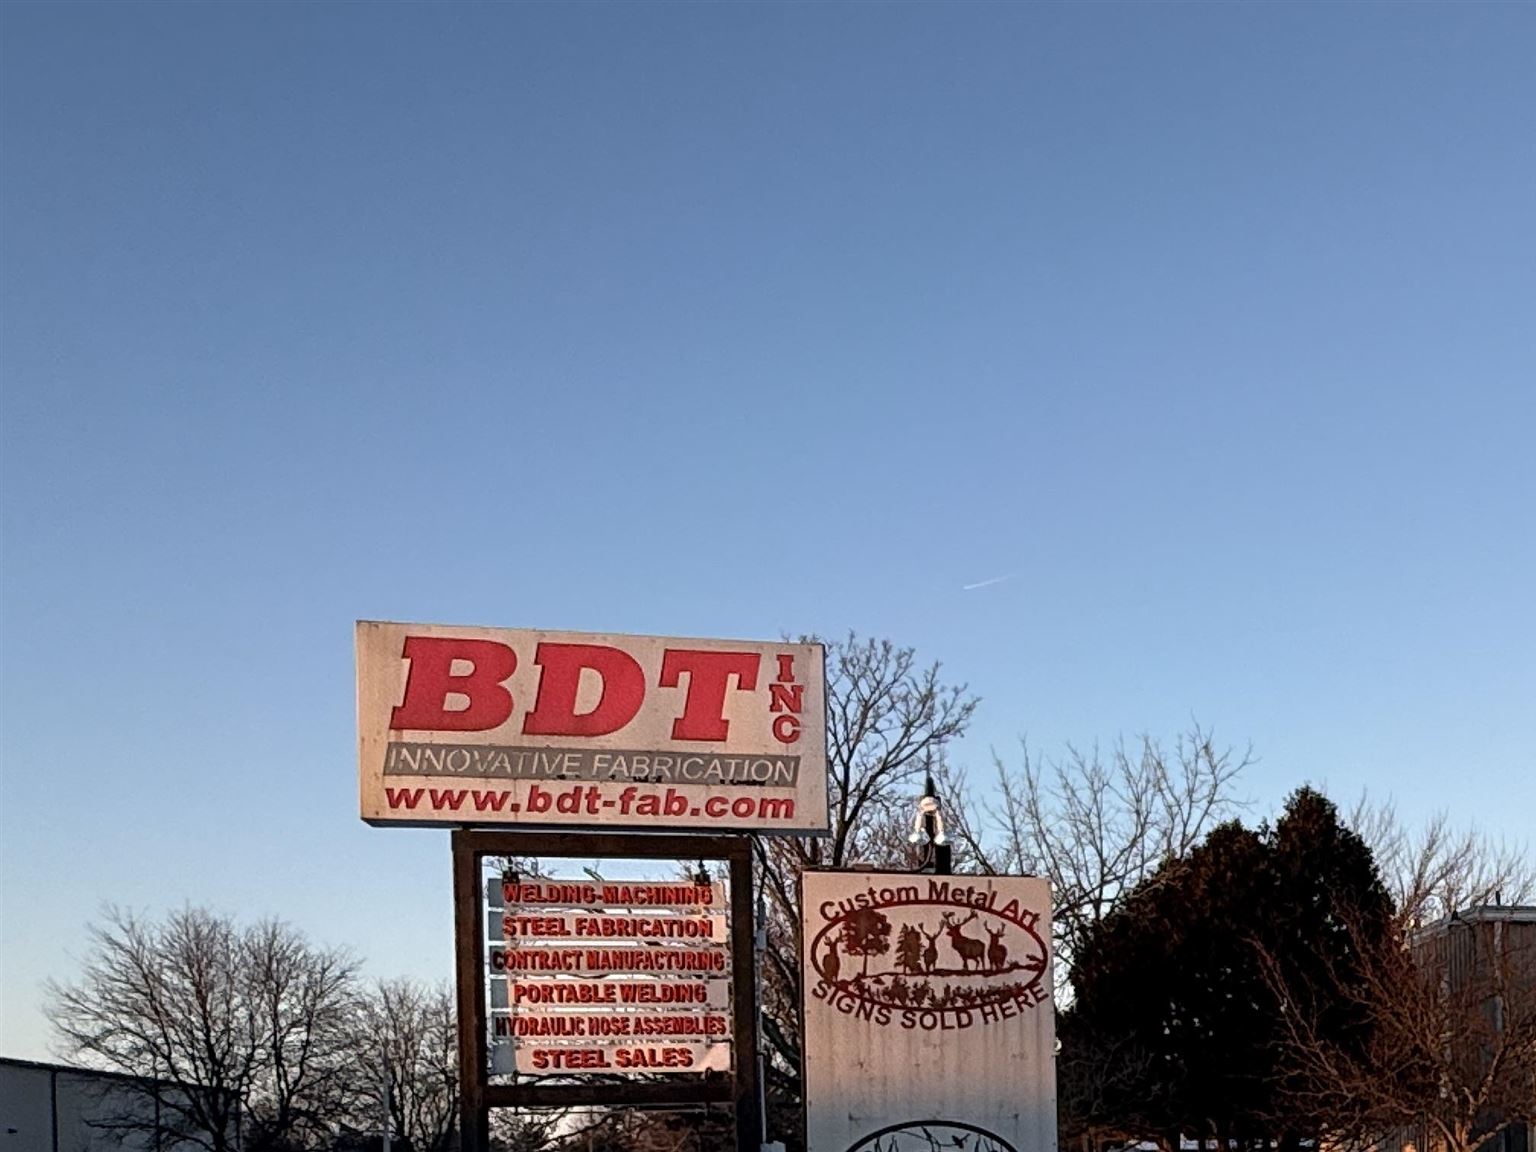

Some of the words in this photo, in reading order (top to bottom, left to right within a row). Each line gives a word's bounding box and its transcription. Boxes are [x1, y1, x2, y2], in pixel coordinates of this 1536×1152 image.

[389, 636, 761, 741] BDT
[769, 654, 803, 744] INC
[388, 747, 582, 777] INNOVATIVE
[588, 754, 795, 783] FABRICATION
[385, 785, 795, 819] www.bdt-fab.com
[820, 886, 919, 922] Custom
[928, 879, 997, 910] Metal
[1002, 897, 1041, 931] Art
[503, 916, 571, 937] STEEL
[576, 918, 713, 938] FABRICATION
[492, 950, 583, 971] CONTRACT
[586, 951, 725, 971] MANUFACTURING
[514, 984, 615, 1003] PORTABLE
[619, 984, 708, 1003] WELDING
[812, 979, 892, 1026] SIGNS
[900, 1010, 973, 1030] SOLD
[980, 982, 1050, 1025] HERE
[495, 1016, 585, 1036] HYDRAULIC
[588, 1016, 630, 1035] HOSE
[633, 1016, 726, 1035] ASSEMBLIES
[532, 1048, 611, 1069] STEEL
[615, 1048, 693, 1068] SALES
